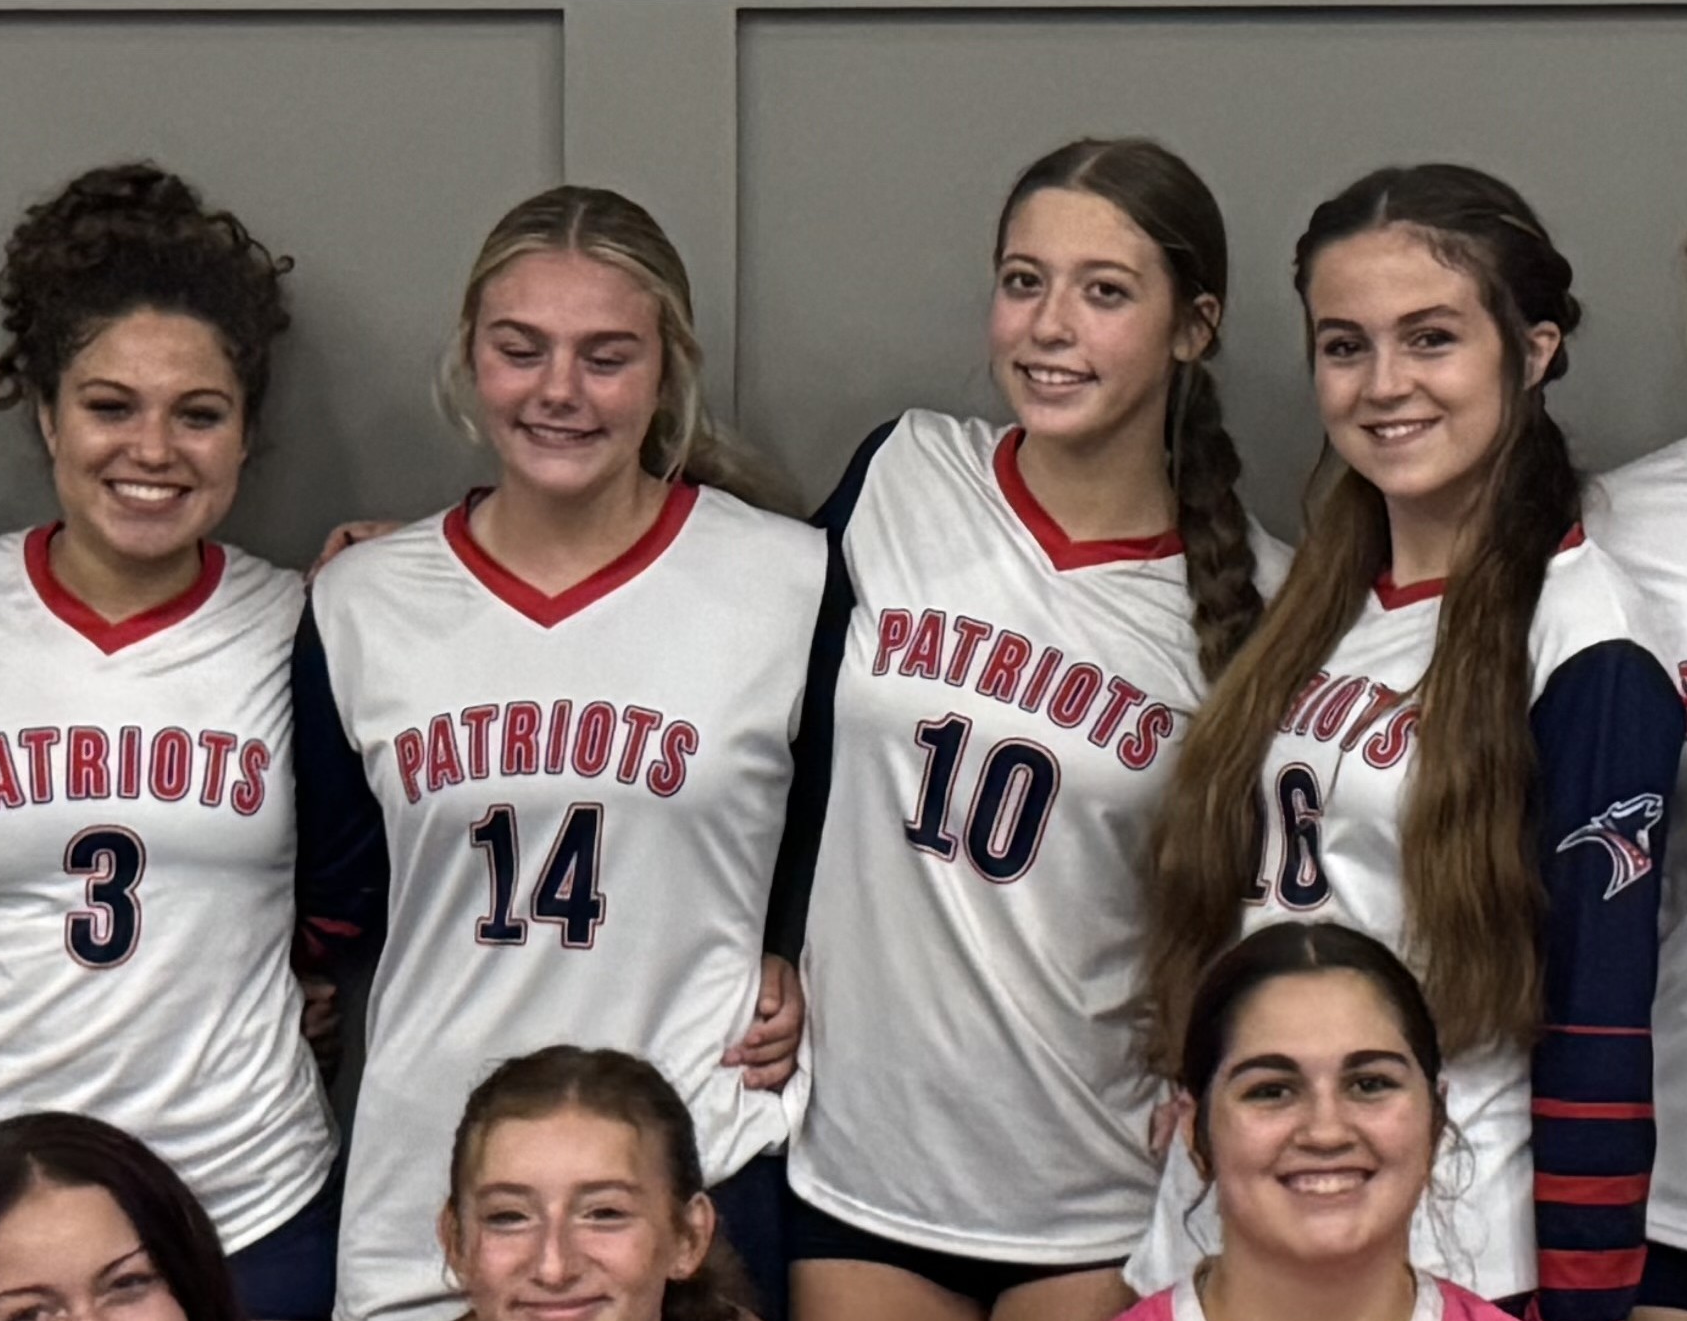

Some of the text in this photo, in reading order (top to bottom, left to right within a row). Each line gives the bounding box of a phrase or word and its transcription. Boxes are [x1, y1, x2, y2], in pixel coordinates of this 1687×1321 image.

[394, 699, 699, 804] PATRIOTS
[872, 608, 1173, 770] PATRIOTS
[903, 712, 1061, 884] 10
[1242, 762, 1333, 912] 6
[63, 824, 146, 970] 3
[469, 802, 606, 950] 14
